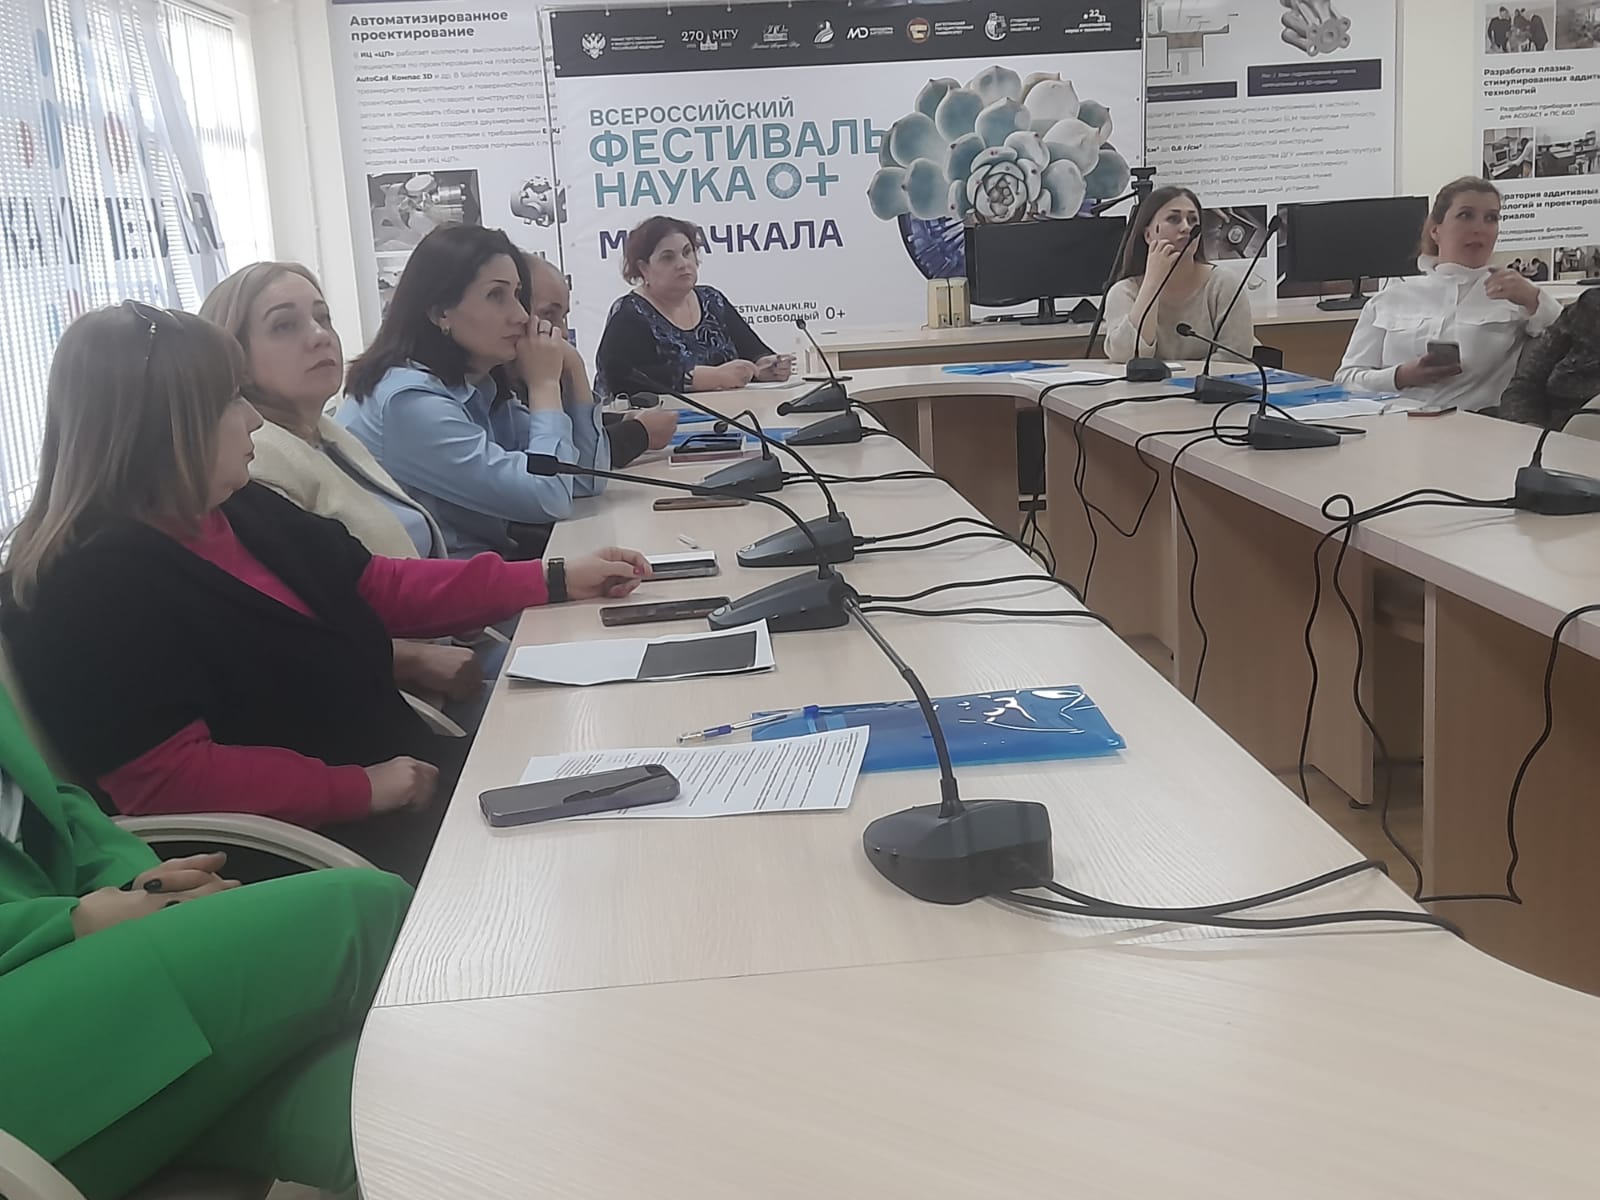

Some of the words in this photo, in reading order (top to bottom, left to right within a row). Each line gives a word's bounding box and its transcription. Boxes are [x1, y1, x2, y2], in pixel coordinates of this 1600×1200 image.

[350, 10, 508, 27] Автоматизированное
[1089, 9, 1100, 17] 22
[351, 26, 475, 42] проектирование
[681, 31, 704, 42] 270
[712, 29, 739, 40] МГУ
[1483, 66, 1536, 76] Разработка
[1537, 64, 1575, 73] плазма-
[1483, 75, 1567, 87] стимулированных
[1483, 86, 1537, 97] технологий
[589, 96, 795, 126] ВСЕРОССИЙСКИЙ
[589, 118, 886, 167] ФЕСТИВАЛЬ
[594, 165, 757, 208] НАУКА
[599, 219, 844, 260] МАЧКАЛА
[825, 306, 846, 320] 0+
